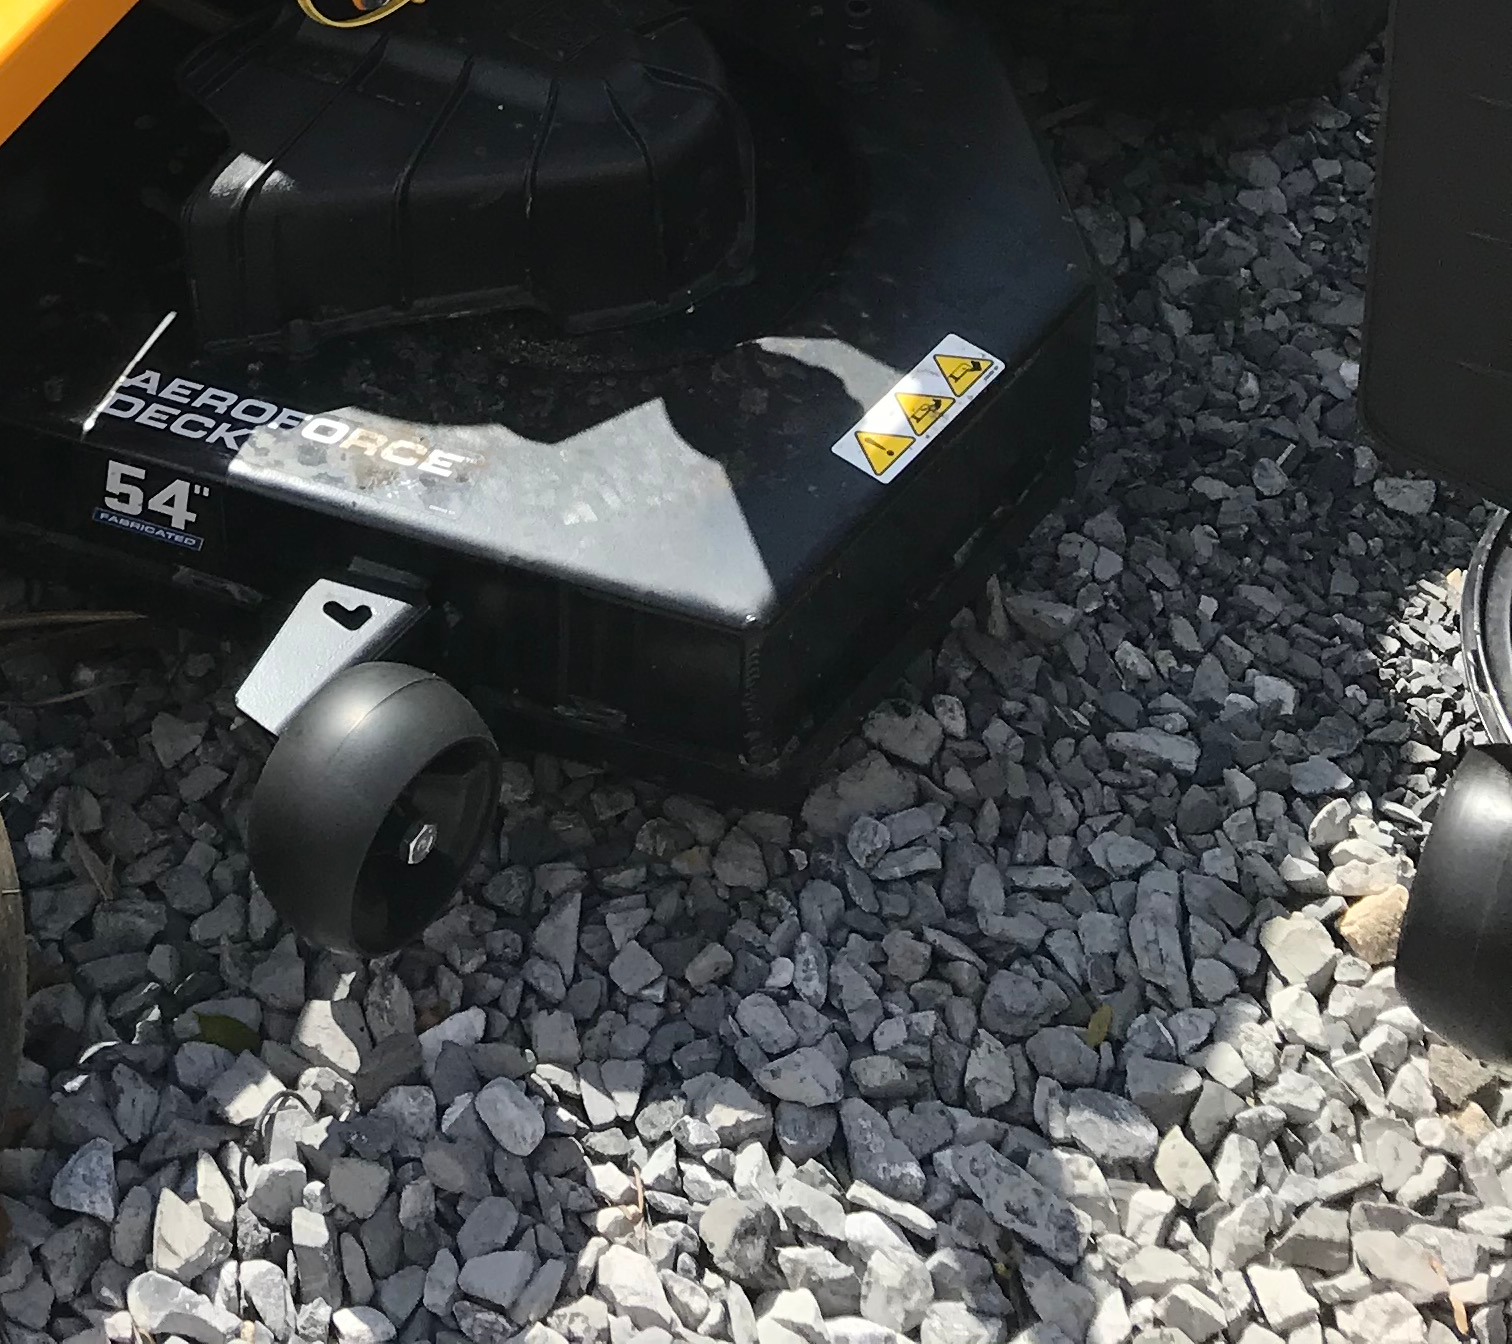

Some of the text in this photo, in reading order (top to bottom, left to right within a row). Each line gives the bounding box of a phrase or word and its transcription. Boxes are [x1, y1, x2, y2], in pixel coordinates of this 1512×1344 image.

[103, 392, 255, 451] DECK
[121, 369, 467, 479] AEROFORCE
[99, 511, 198, 547] FABRICATED
